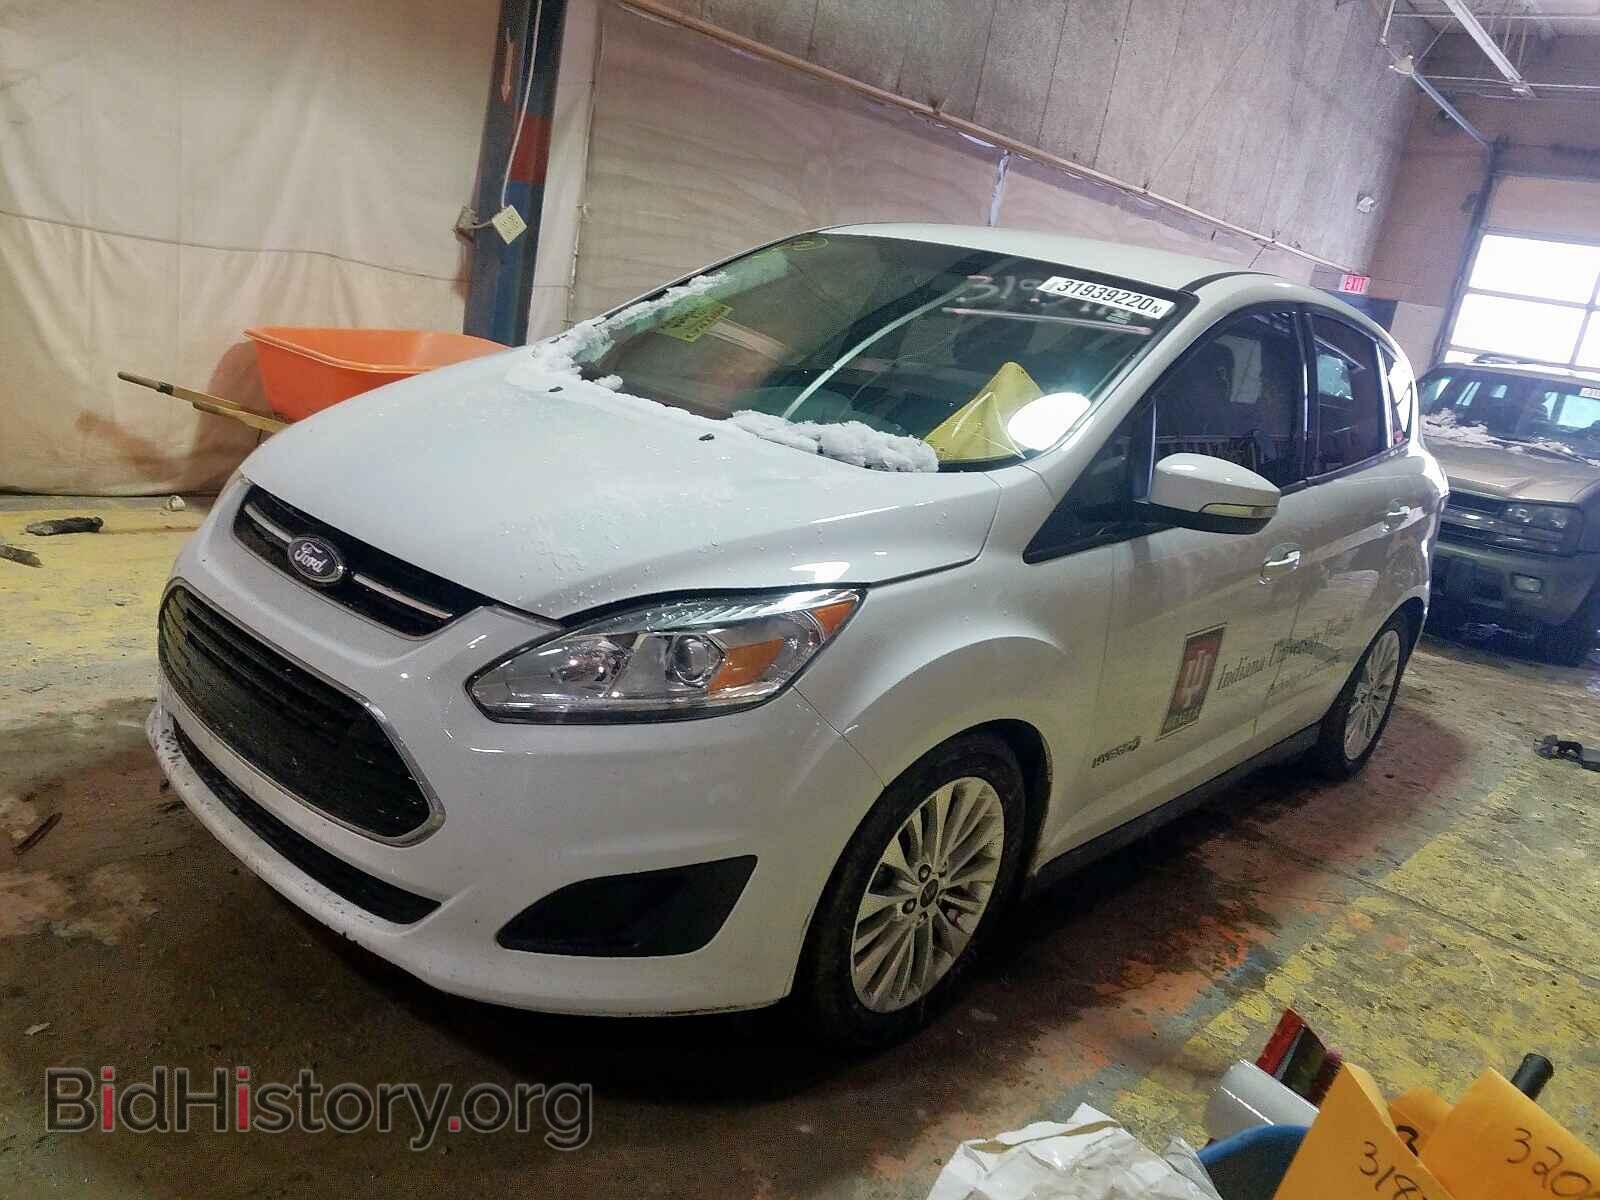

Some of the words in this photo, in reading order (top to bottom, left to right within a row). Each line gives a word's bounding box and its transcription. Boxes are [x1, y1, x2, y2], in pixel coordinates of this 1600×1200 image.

[1057, 280, 1154, 311] 31939220
[1344, 276, 1366, 291] EXIT
[294, 542, 328, 573] Ford
[1360, 1141, 1427, 1200] 318
[1507, 1127, 1600, 1198] 320
